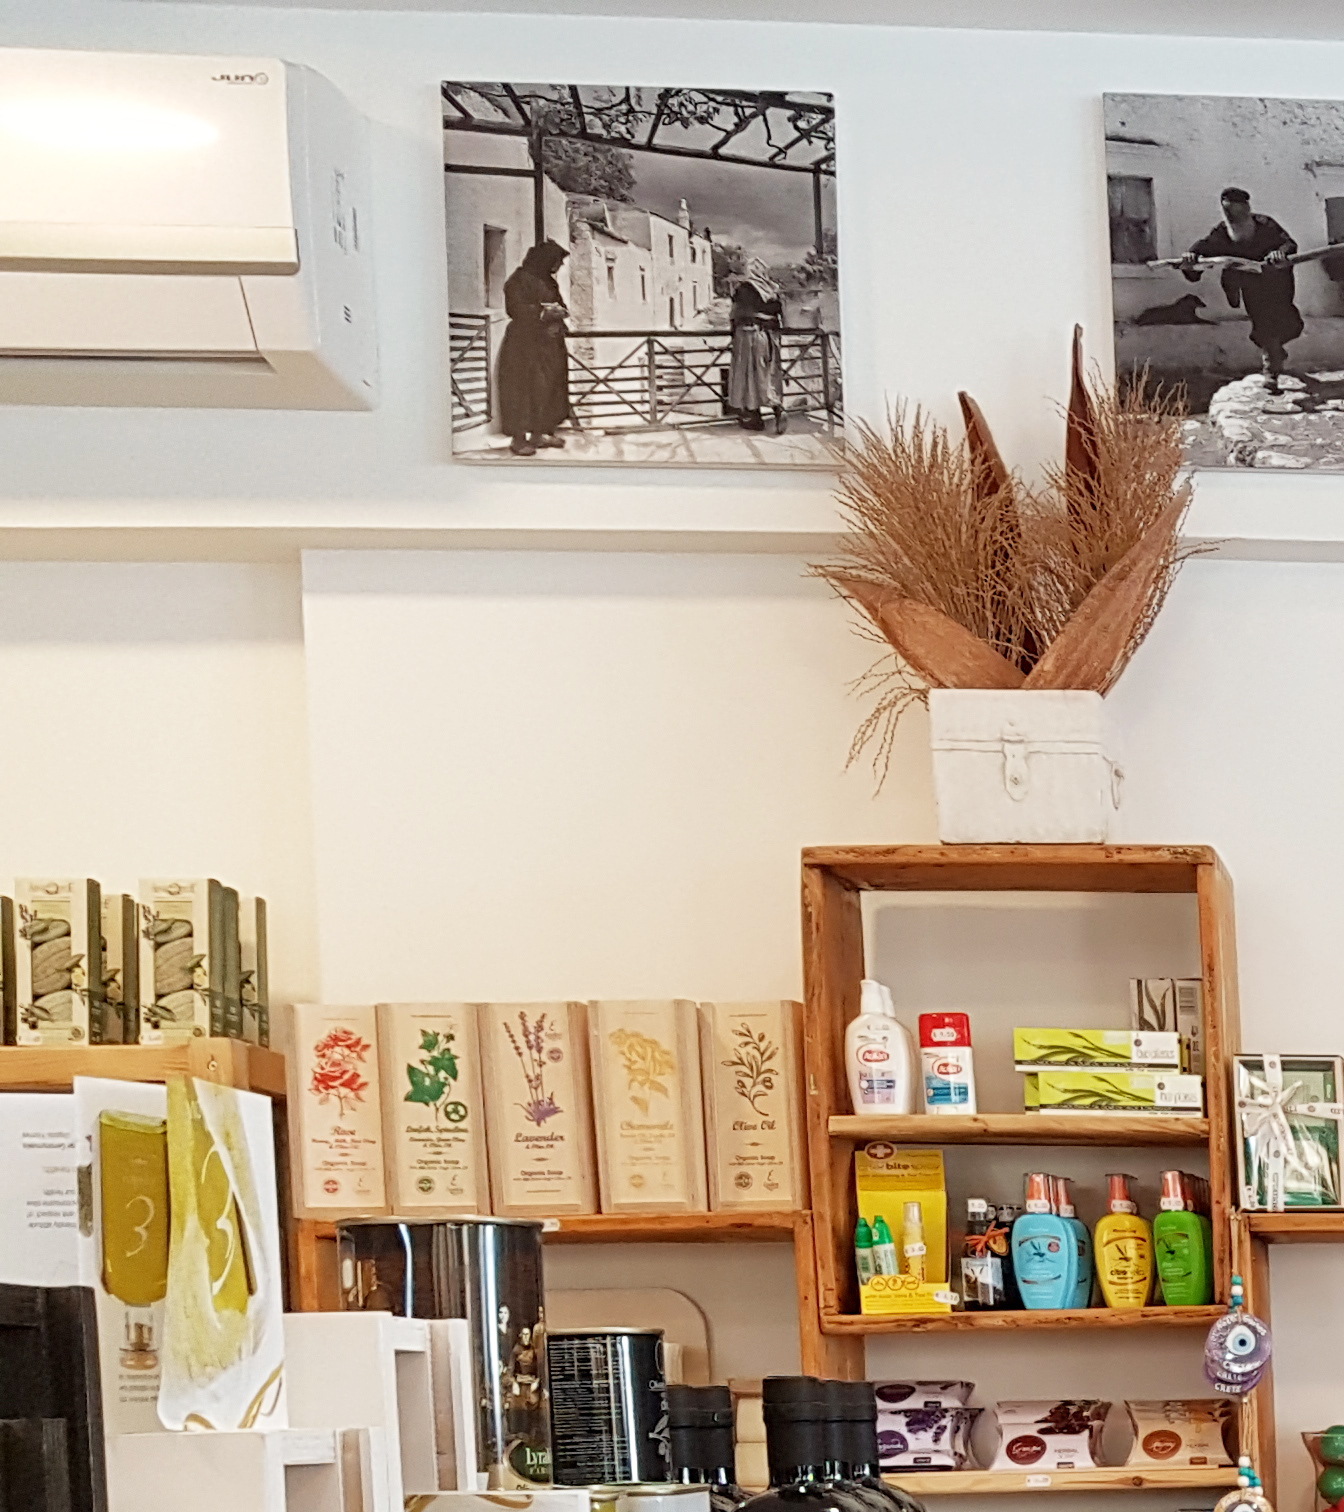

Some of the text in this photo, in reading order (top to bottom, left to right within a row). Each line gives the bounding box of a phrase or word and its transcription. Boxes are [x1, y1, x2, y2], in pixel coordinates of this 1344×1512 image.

[732, 1120, 776, 1131] Olive Oil
[513, 1132, 565, 1142] Lavender
